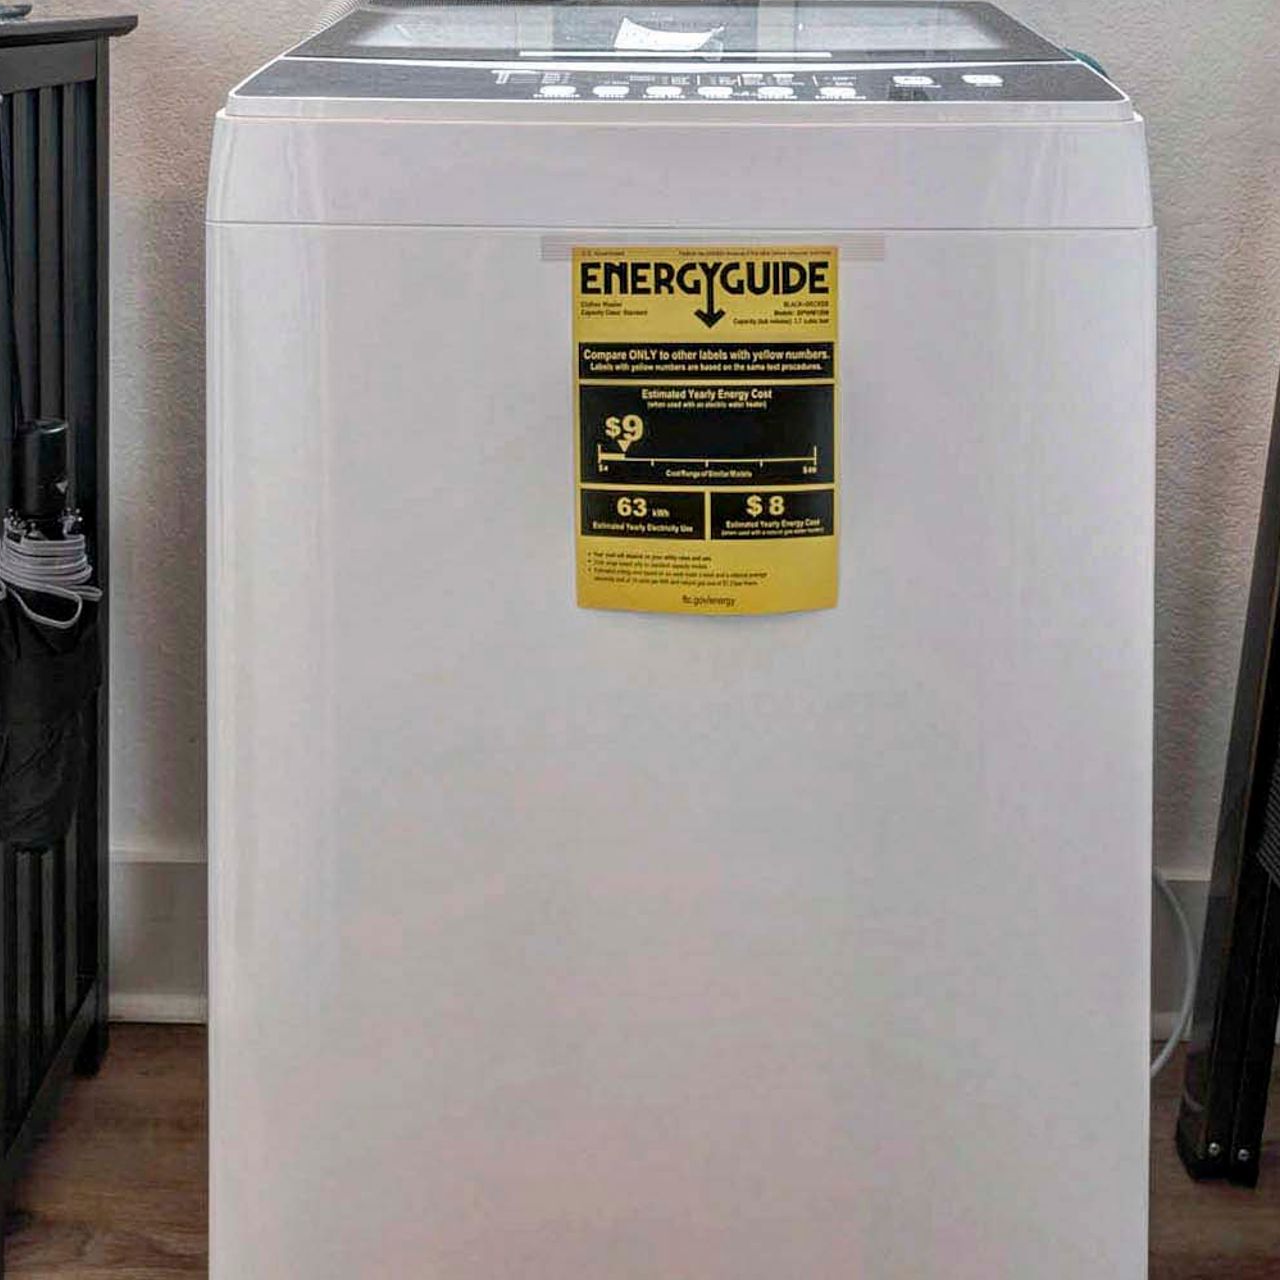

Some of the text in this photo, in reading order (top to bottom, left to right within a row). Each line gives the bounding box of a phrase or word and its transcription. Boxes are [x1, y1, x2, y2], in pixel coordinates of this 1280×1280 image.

[580, 261, 829, 310] ENERGYGUIDE
[583, 347, 830, 363] Compare ONLY to other labels with yellow numbers.
[641, 388, 772, 400] Estimated Yearly Energy Cost
[605, 414, 644, 442] $9
[616, 496, 647, 517] 63
